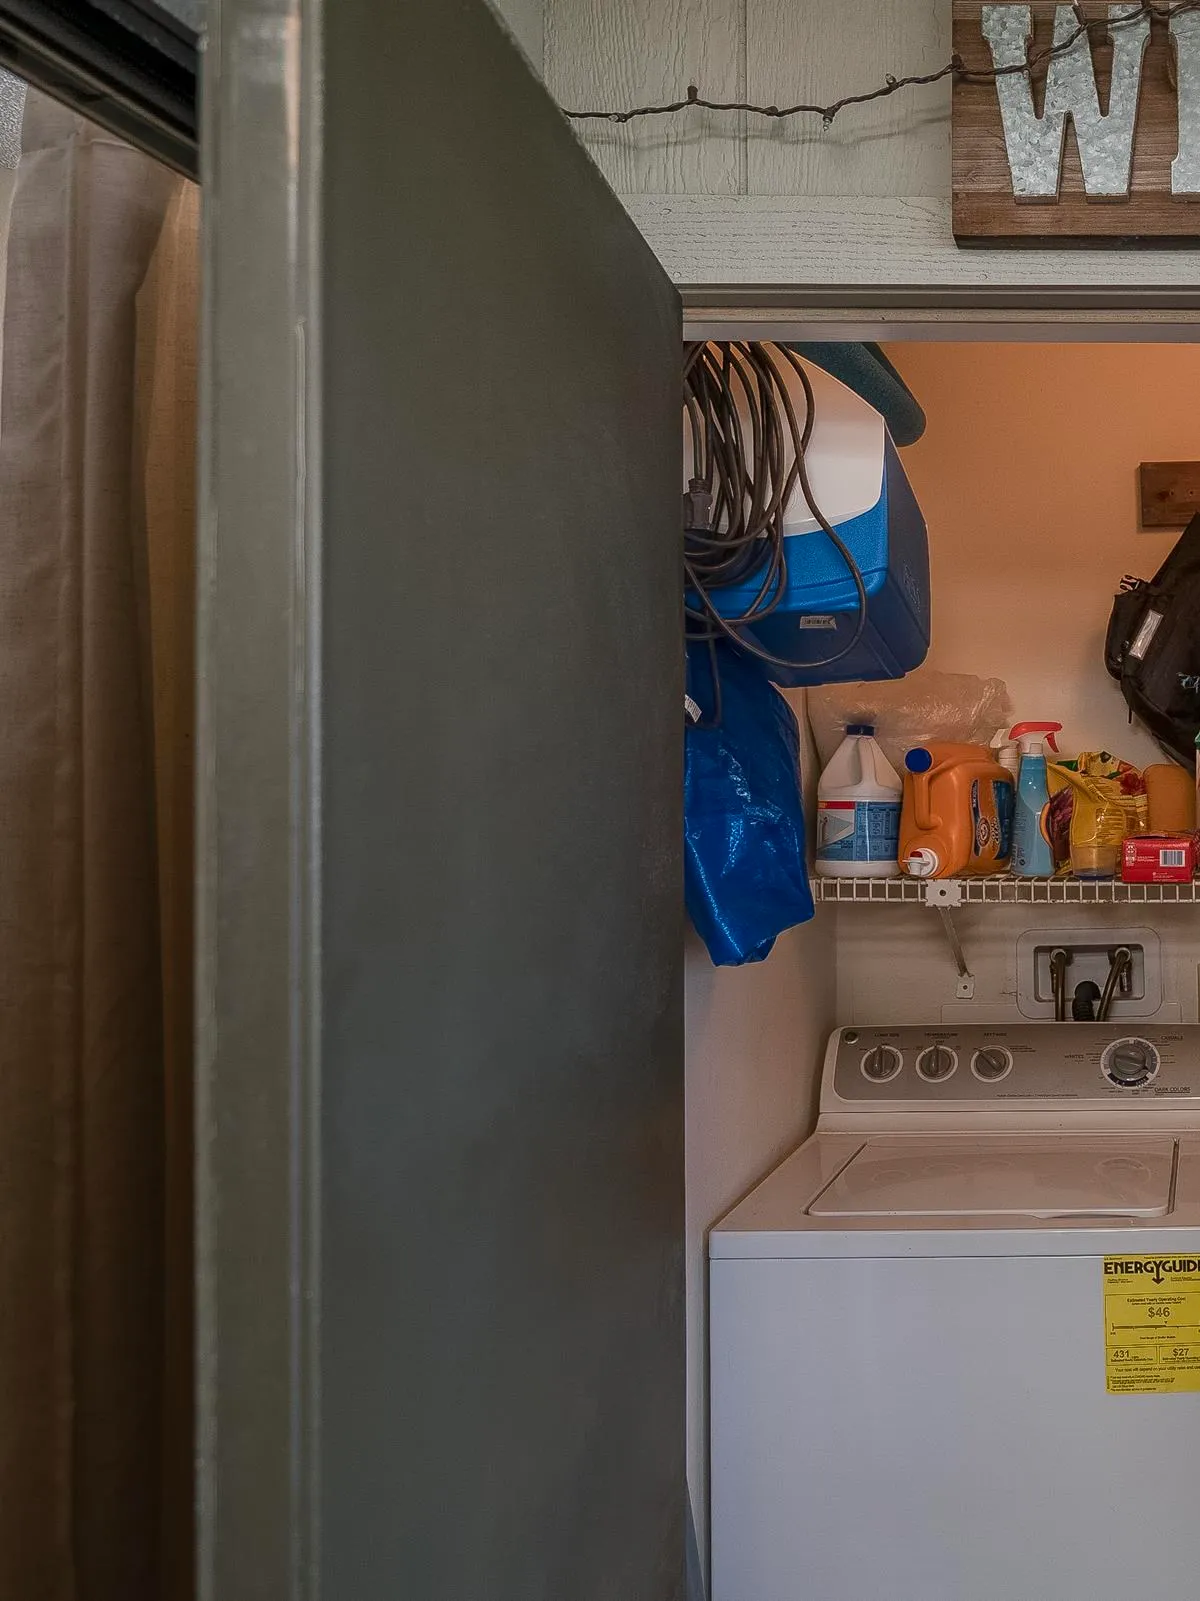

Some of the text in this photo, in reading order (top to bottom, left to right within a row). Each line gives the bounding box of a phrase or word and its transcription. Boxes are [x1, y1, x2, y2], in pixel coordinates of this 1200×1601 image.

[1148, 1306, 1171, 1319] $46
[1113, 1350, 1130, 1359] 431
[1172, 1348, 1190, 1358] $27
